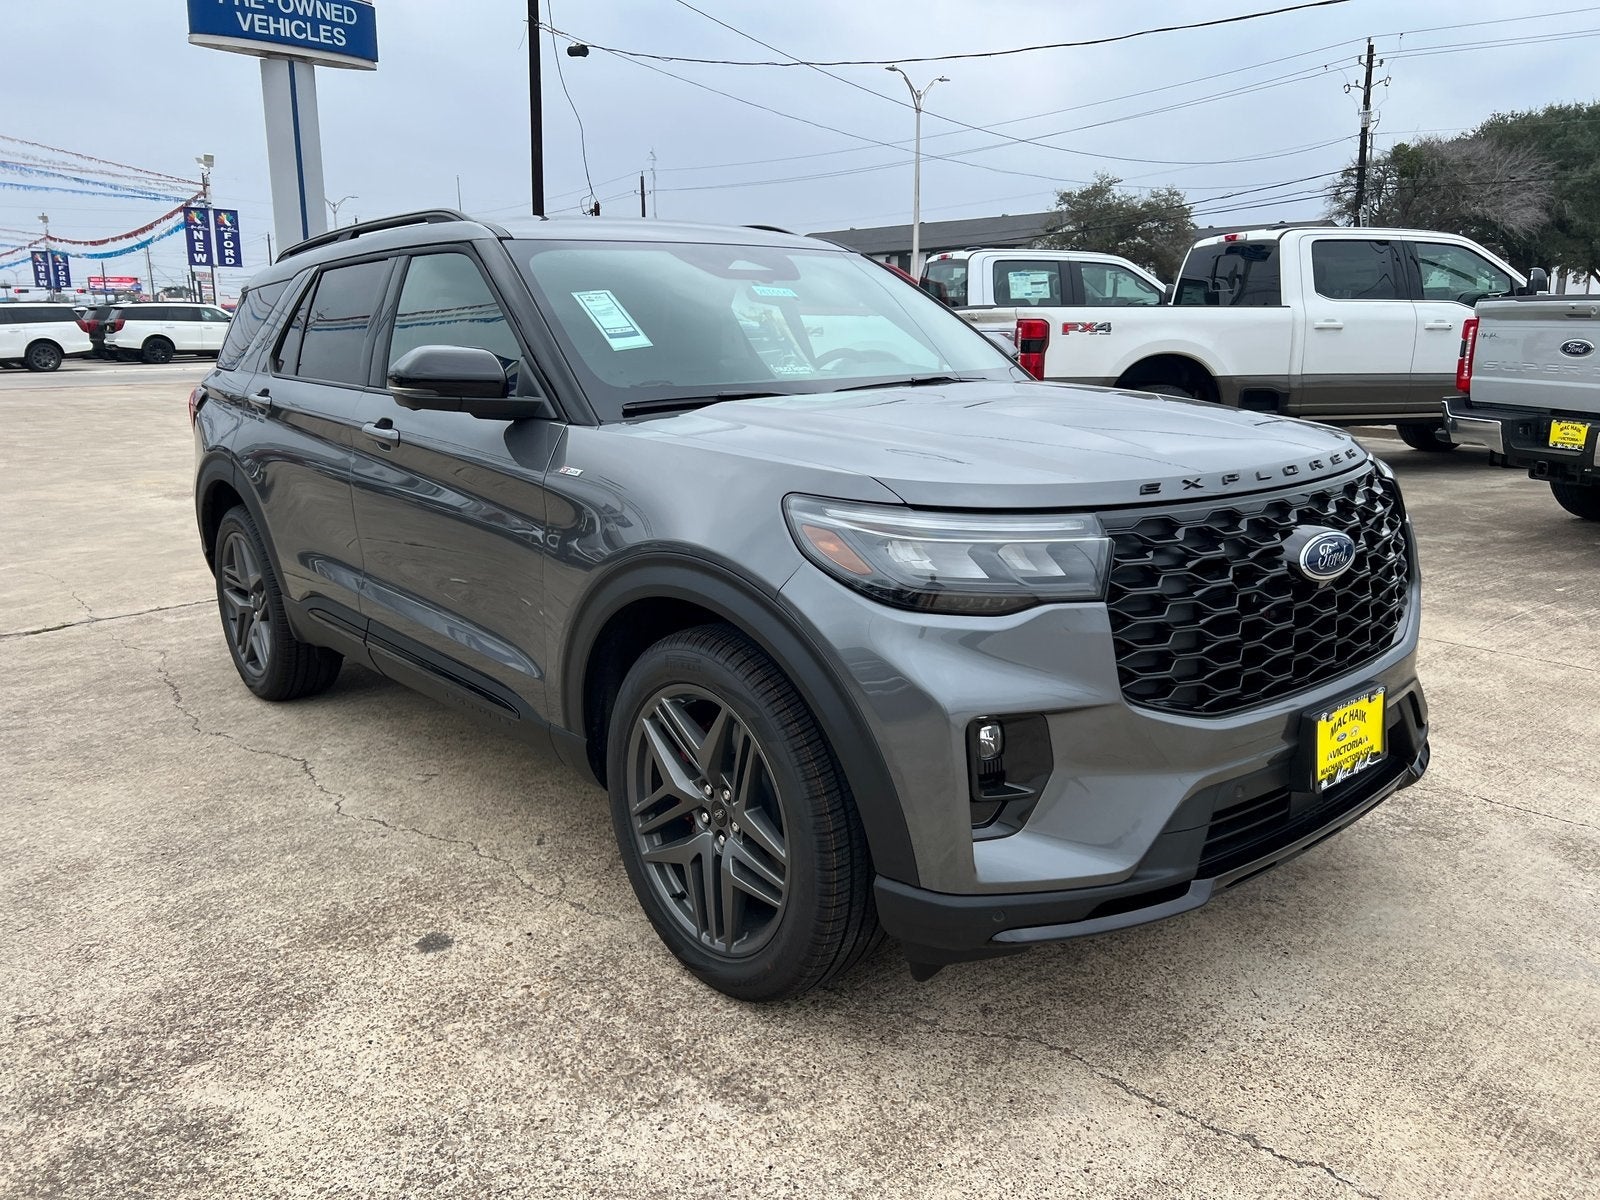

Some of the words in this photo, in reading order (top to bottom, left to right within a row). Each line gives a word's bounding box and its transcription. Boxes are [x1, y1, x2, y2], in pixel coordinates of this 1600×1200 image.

[218, 0, 357, 25] -OWNED
[235, 11, 347, 47] VEHICLES
[193, 230, 207, 263] NEW
[223, 232, 235, 265] FORD
[37, 265, 48, 286] NEW
[58, 265, 67, 286] FORD
[1062, 322, 1112, 335] FX4
[1566, 342, 1585, 354] Ford
[1482, 360, 1584, 376] SUPER
[1139, 448, 1358, 495] EXPLORER
[1318, 541, 1347, 570] Ford
[1330, 712, 1348, 740] MAC
[1349, 708, 1367, 724] HAIK
[1332, 737, 1363, 759] VICTORIA
